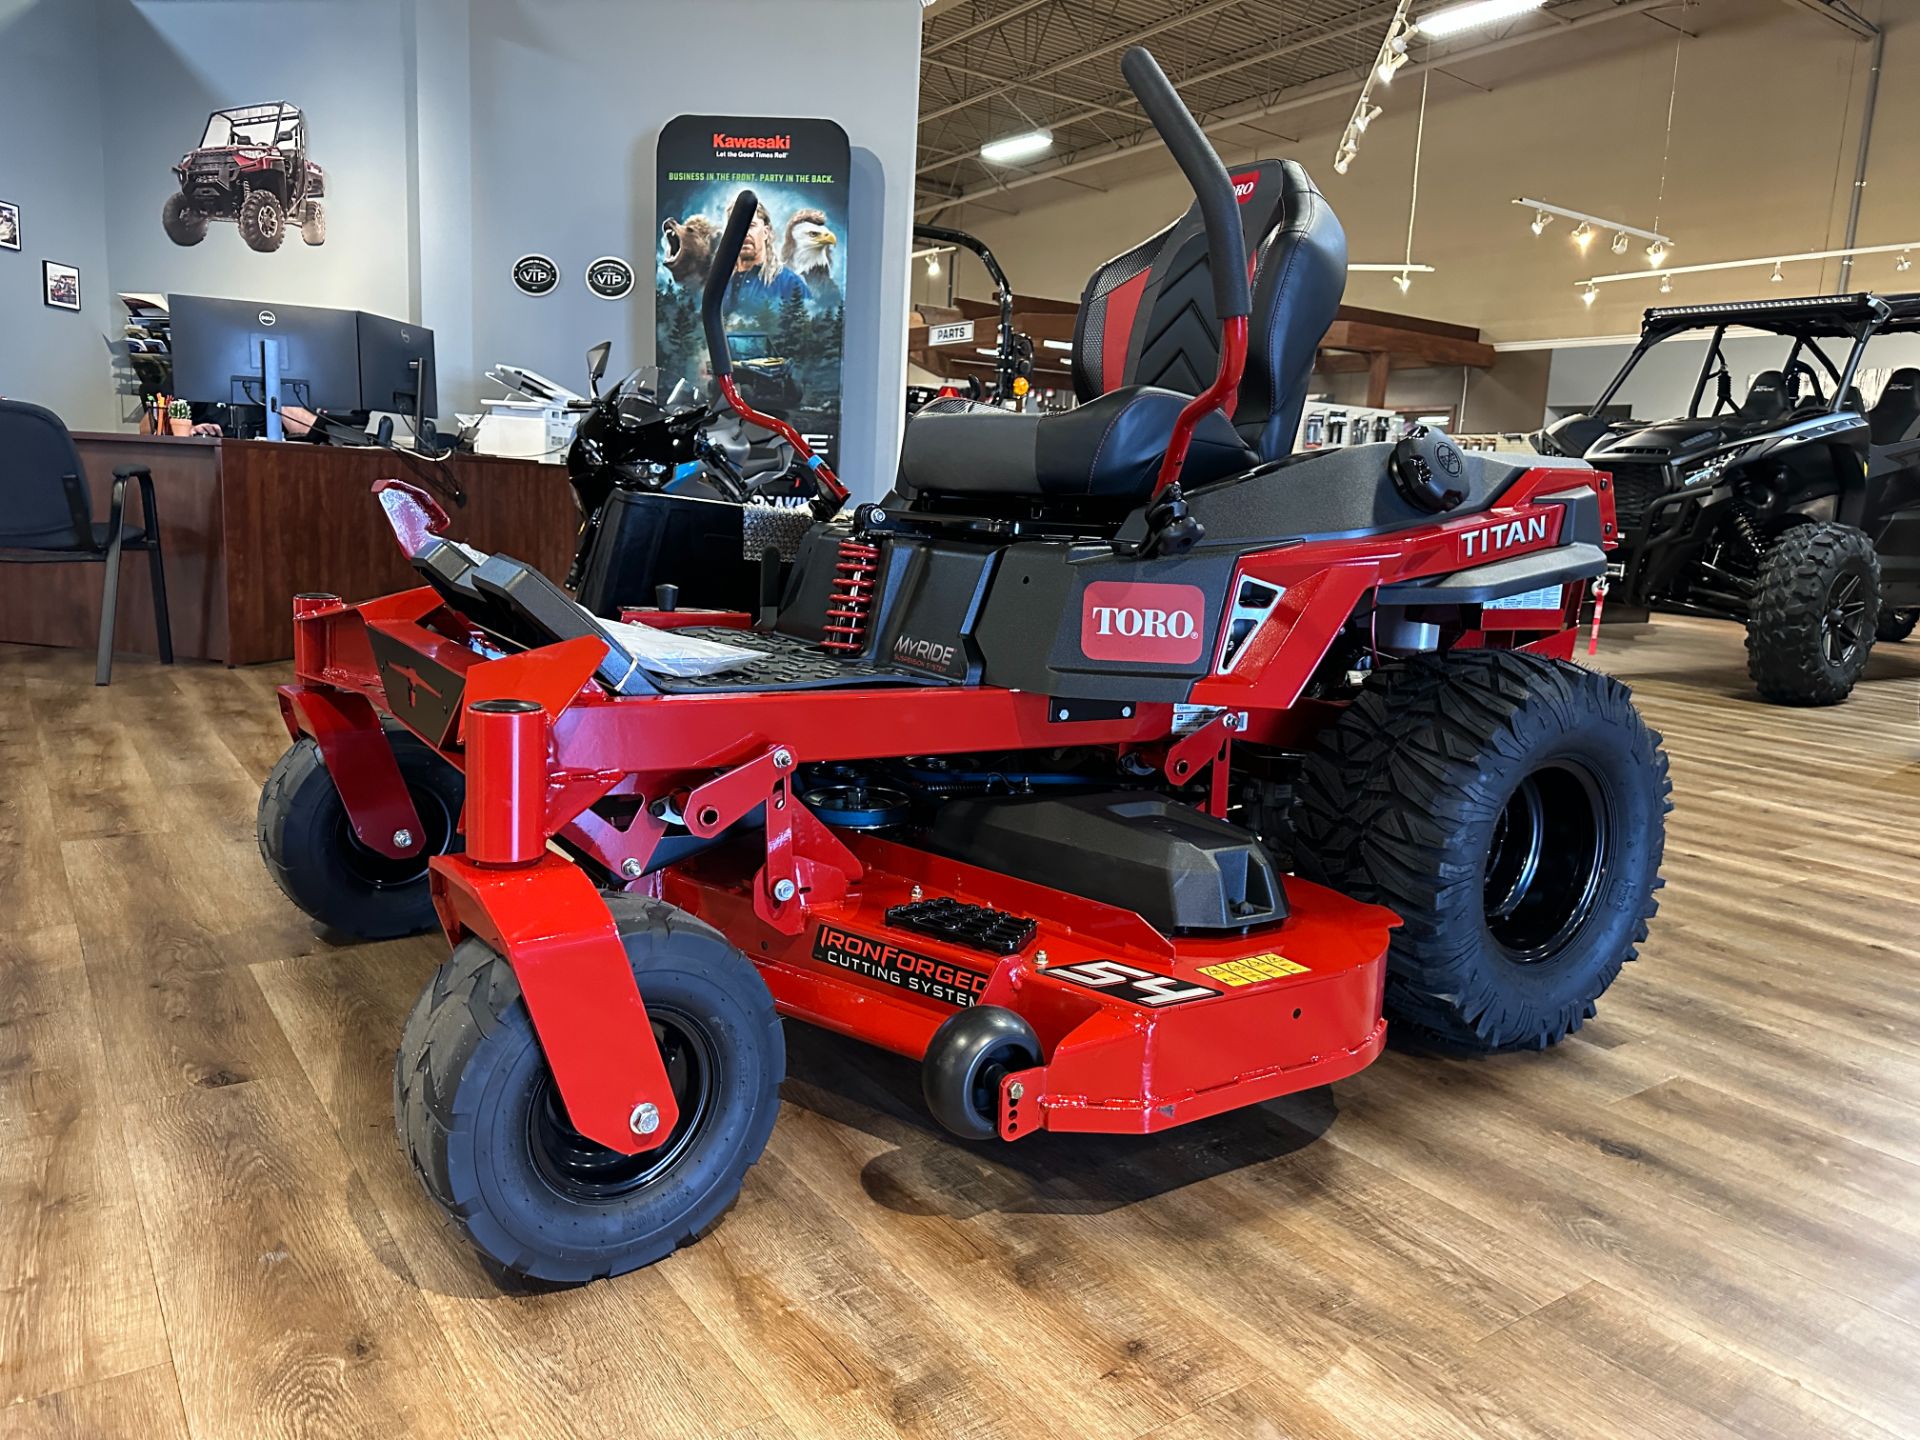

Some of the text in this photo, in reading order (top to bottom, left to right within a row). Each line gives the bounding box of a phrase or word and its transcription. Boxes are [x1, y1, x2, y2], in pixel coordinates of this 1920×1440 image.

[713, 133, 791, 149] Kawasaki
[668, 172, 835, 184] BUSINESS IN THE FRONT. PARTY IN THE BACK.
[1233, 181, 1254, 196] RO
[522, 271, 547, 282] VIP
[597, 274, 622, 285] VIP
[937, 327, 965, 340] PARTS
[1460, 514, 1547, 558] TITAN
[1092, 606, 1195, 638] TORO
[827, 951, 900, 985] CUTTING
[1046, 960, 1217, 1005] 54
